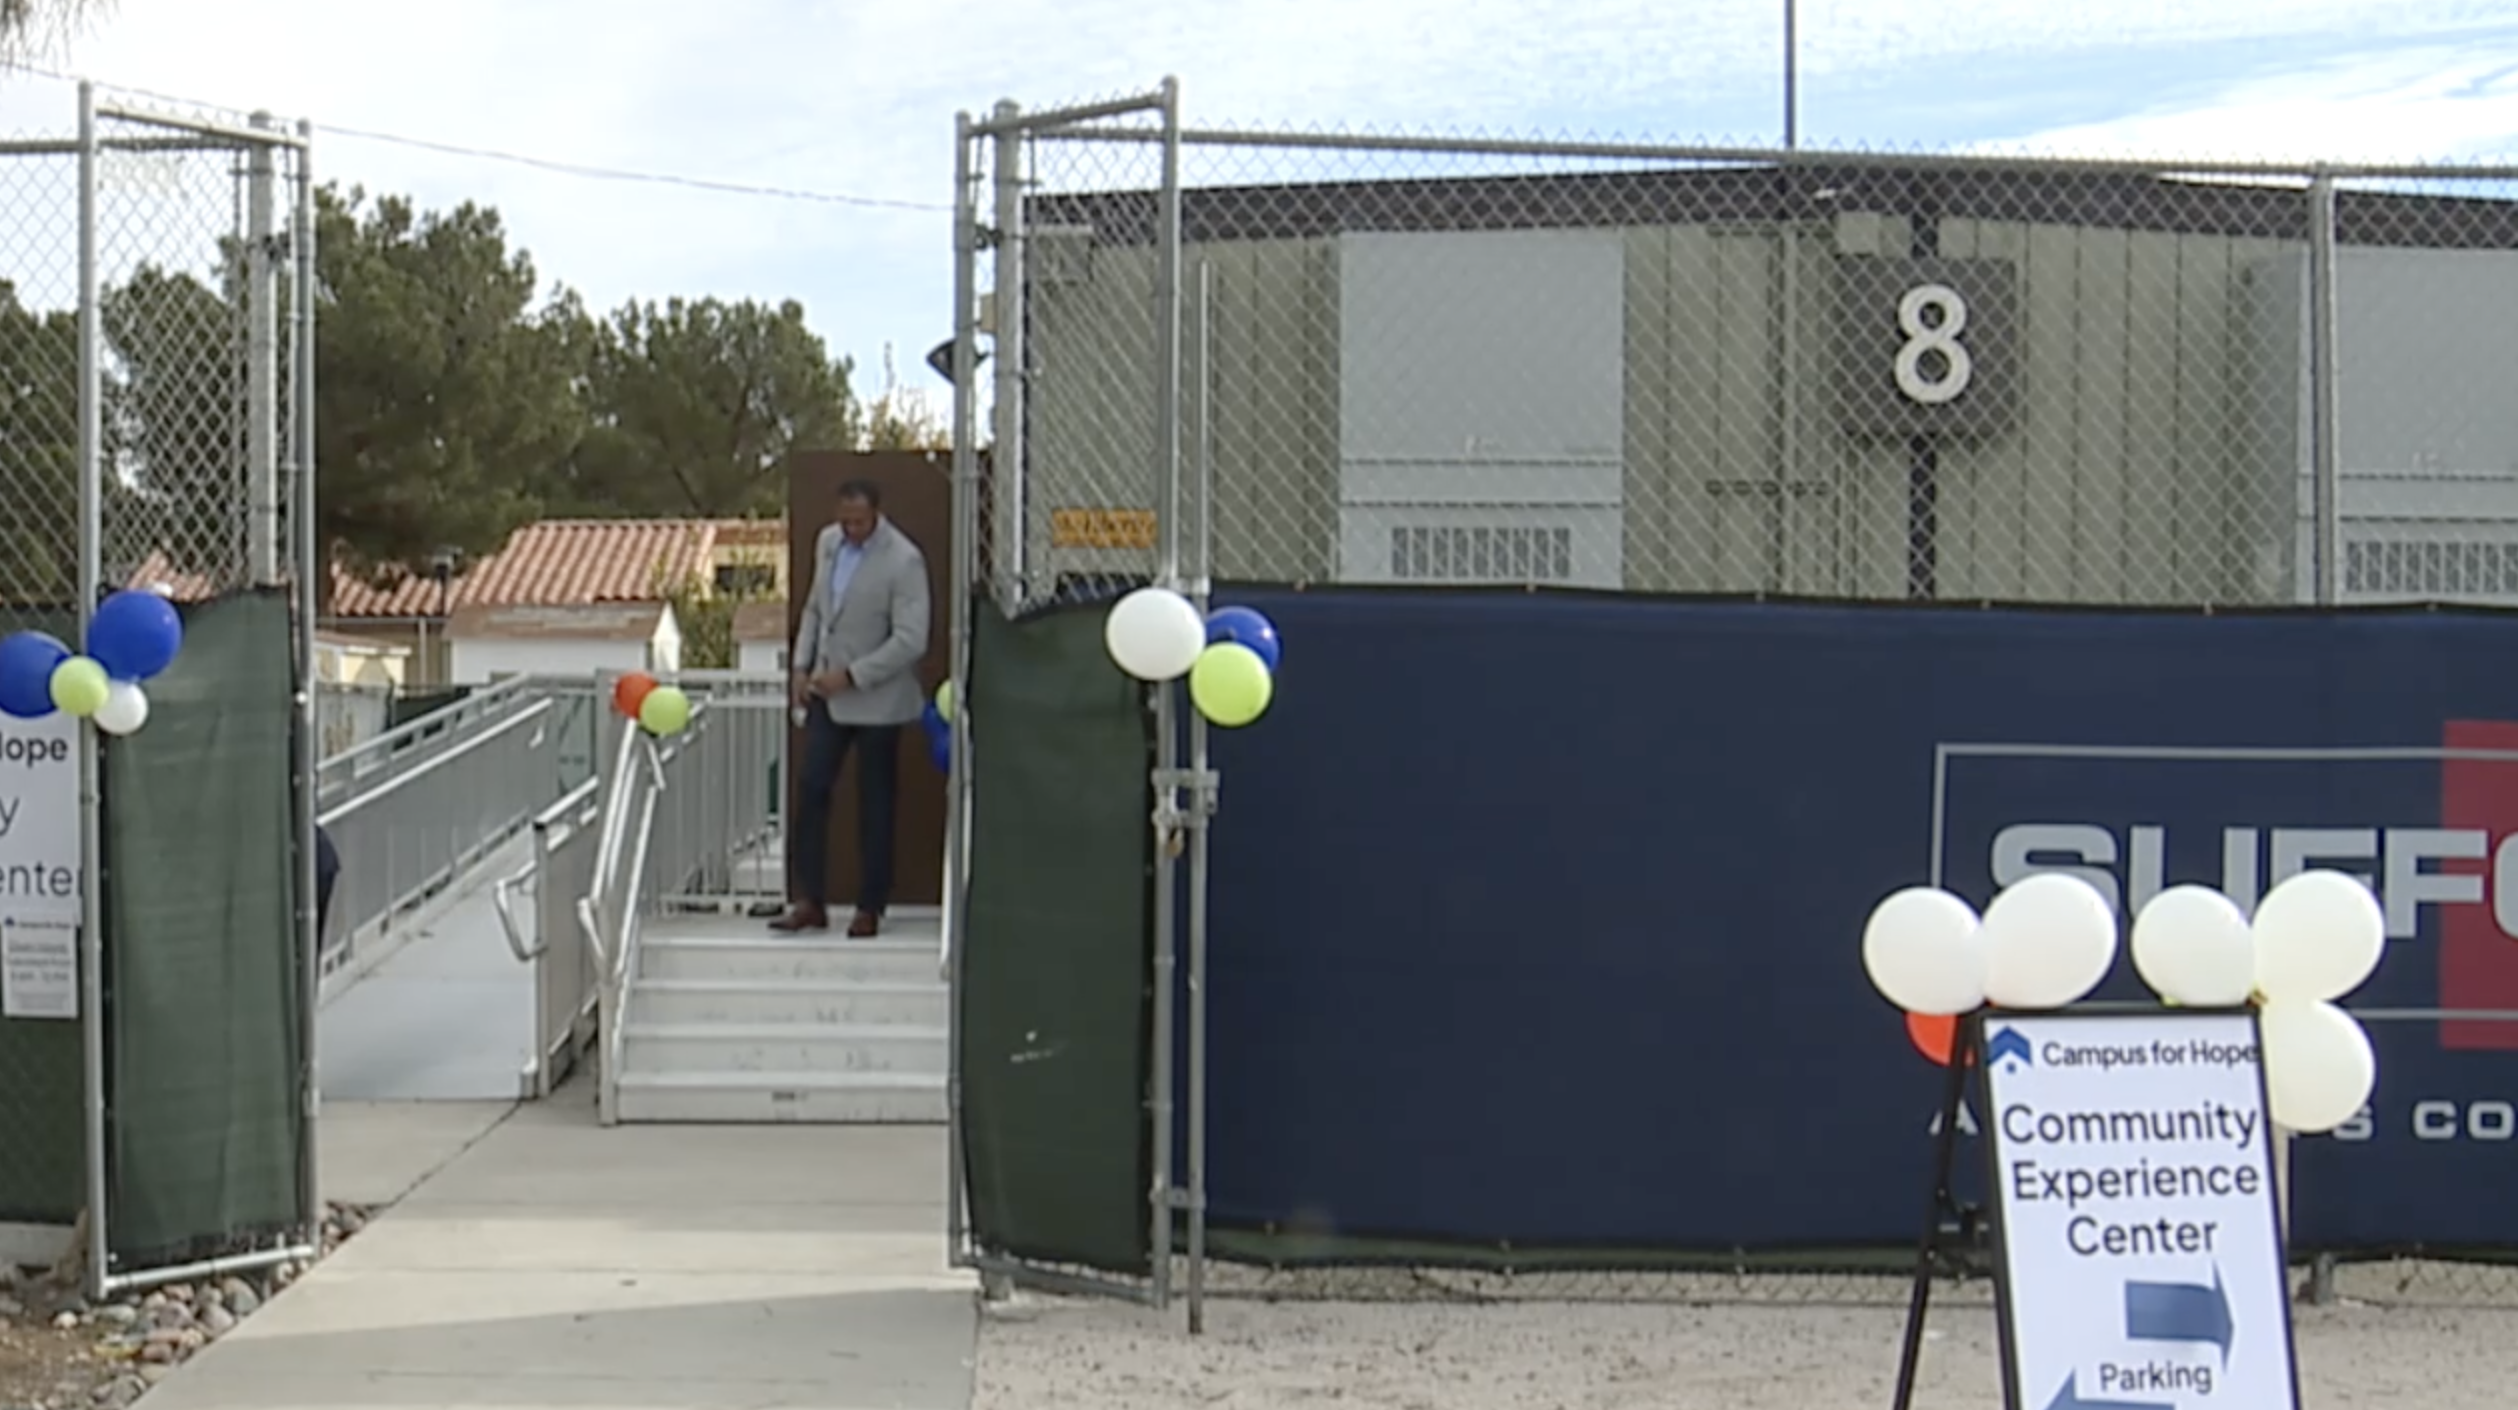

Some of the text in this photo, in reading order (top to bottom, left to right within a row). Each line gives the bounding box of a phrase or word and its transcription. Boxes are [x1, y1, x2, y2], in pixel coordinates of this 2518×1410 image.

[1895, 283, 1972, 403] 8
[0, 732, 68, 769] ope
[0, 860, 84, 898] nte
[1991, 823, 2518, 939] SUFF
[2042, 1039, 2260, 1070] Campus for Hope
[2002, 1101, 2257, 1149] Community
[2012, 1158, 2259, 1208] Experience
[2067, 1215, 2217, 1256] Center
[2099, 1360, 2212, 1395] Parking
